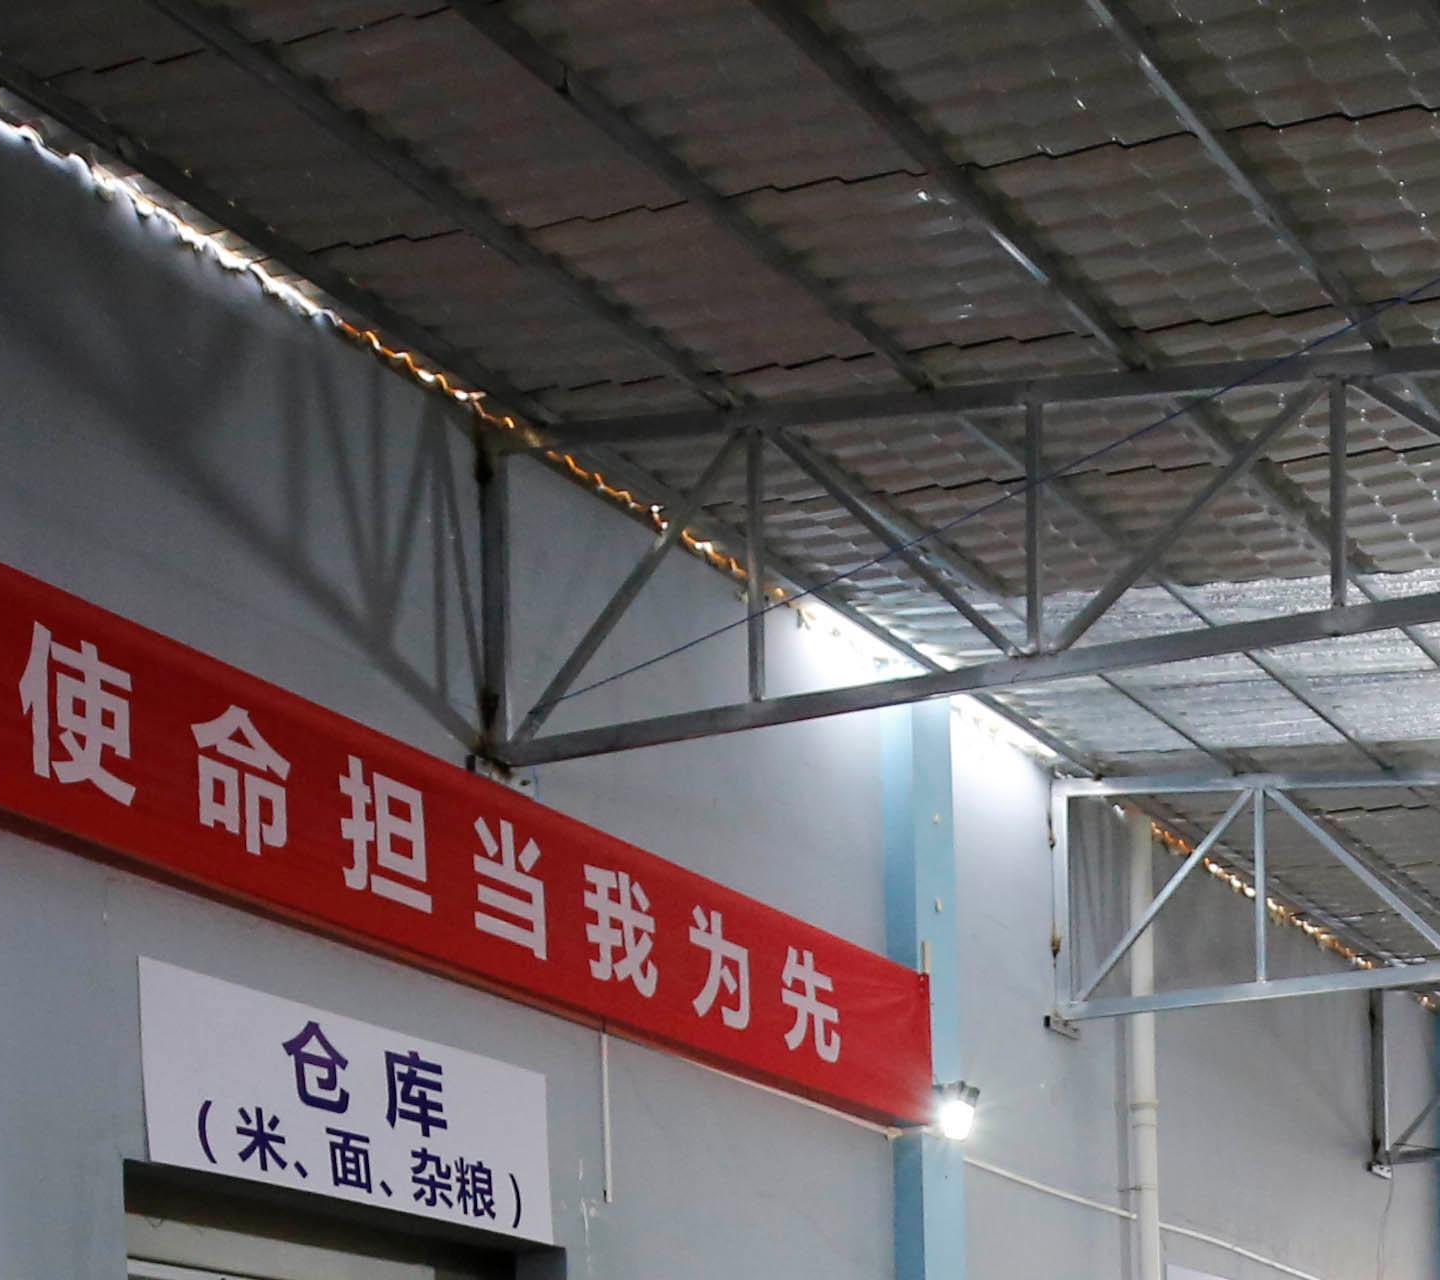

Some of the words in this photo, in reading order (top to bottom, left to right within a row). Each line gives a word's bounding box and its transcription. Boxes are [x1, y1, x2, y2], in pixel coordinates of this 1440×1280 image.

[17, 620, 842, 1062] 使命担当我为先
[281, 1019, 450, 1138] 仓库
